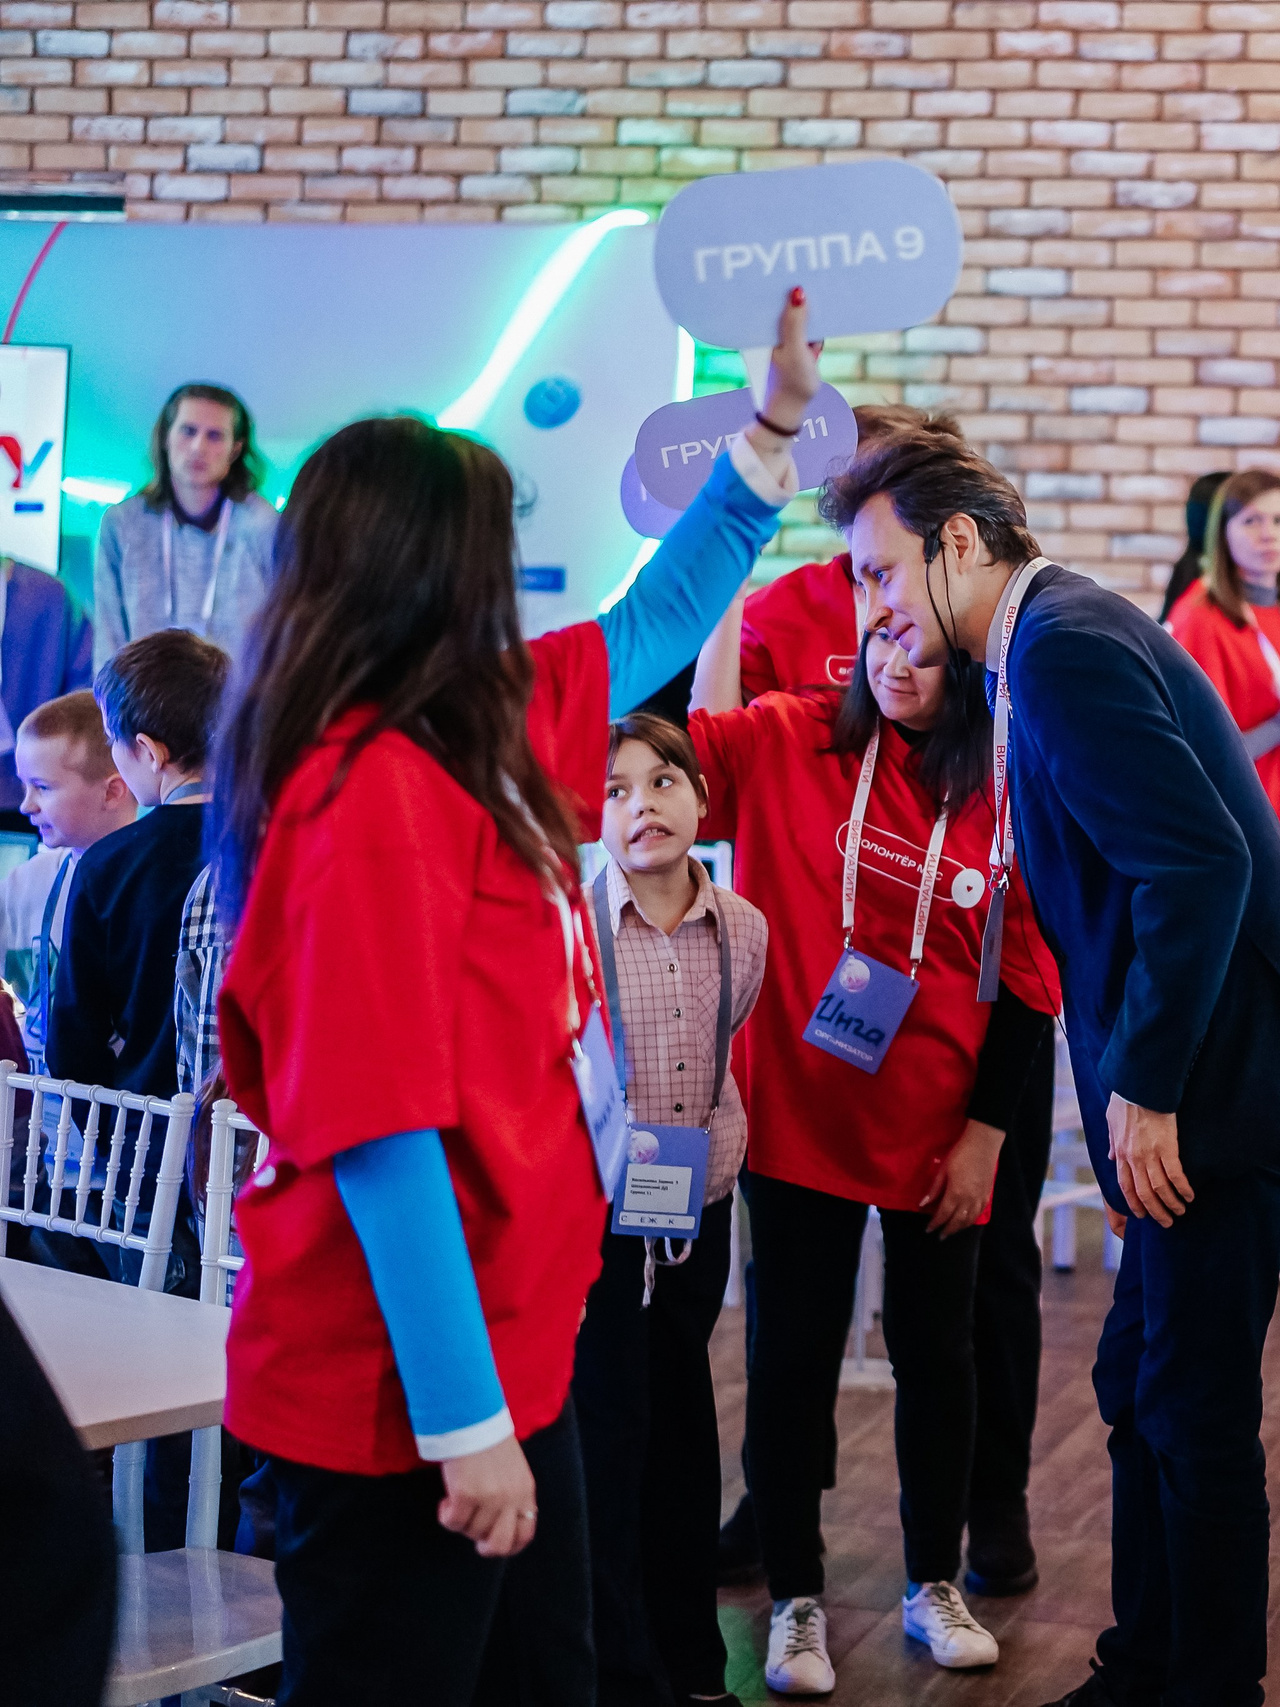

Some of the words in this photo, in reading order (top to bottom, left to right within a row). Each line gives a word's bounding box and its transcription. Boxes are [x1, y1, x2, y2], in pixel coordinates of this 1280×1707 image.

[694, 230, 887, 283] ГРУППА
[894, 226, 925, 260] 9
[660, 431, 800, 469] ГРУ
[803, 416, 829, 440] 11
[845, 818, 861, 902] ВИРТУАЛИТИ
[860, 837, 917, 869] ОЛОНТЁР
[916, 853, 938, 936] ВИРТУАЛИТИ
[816, 992, 886, 1048] Инга
